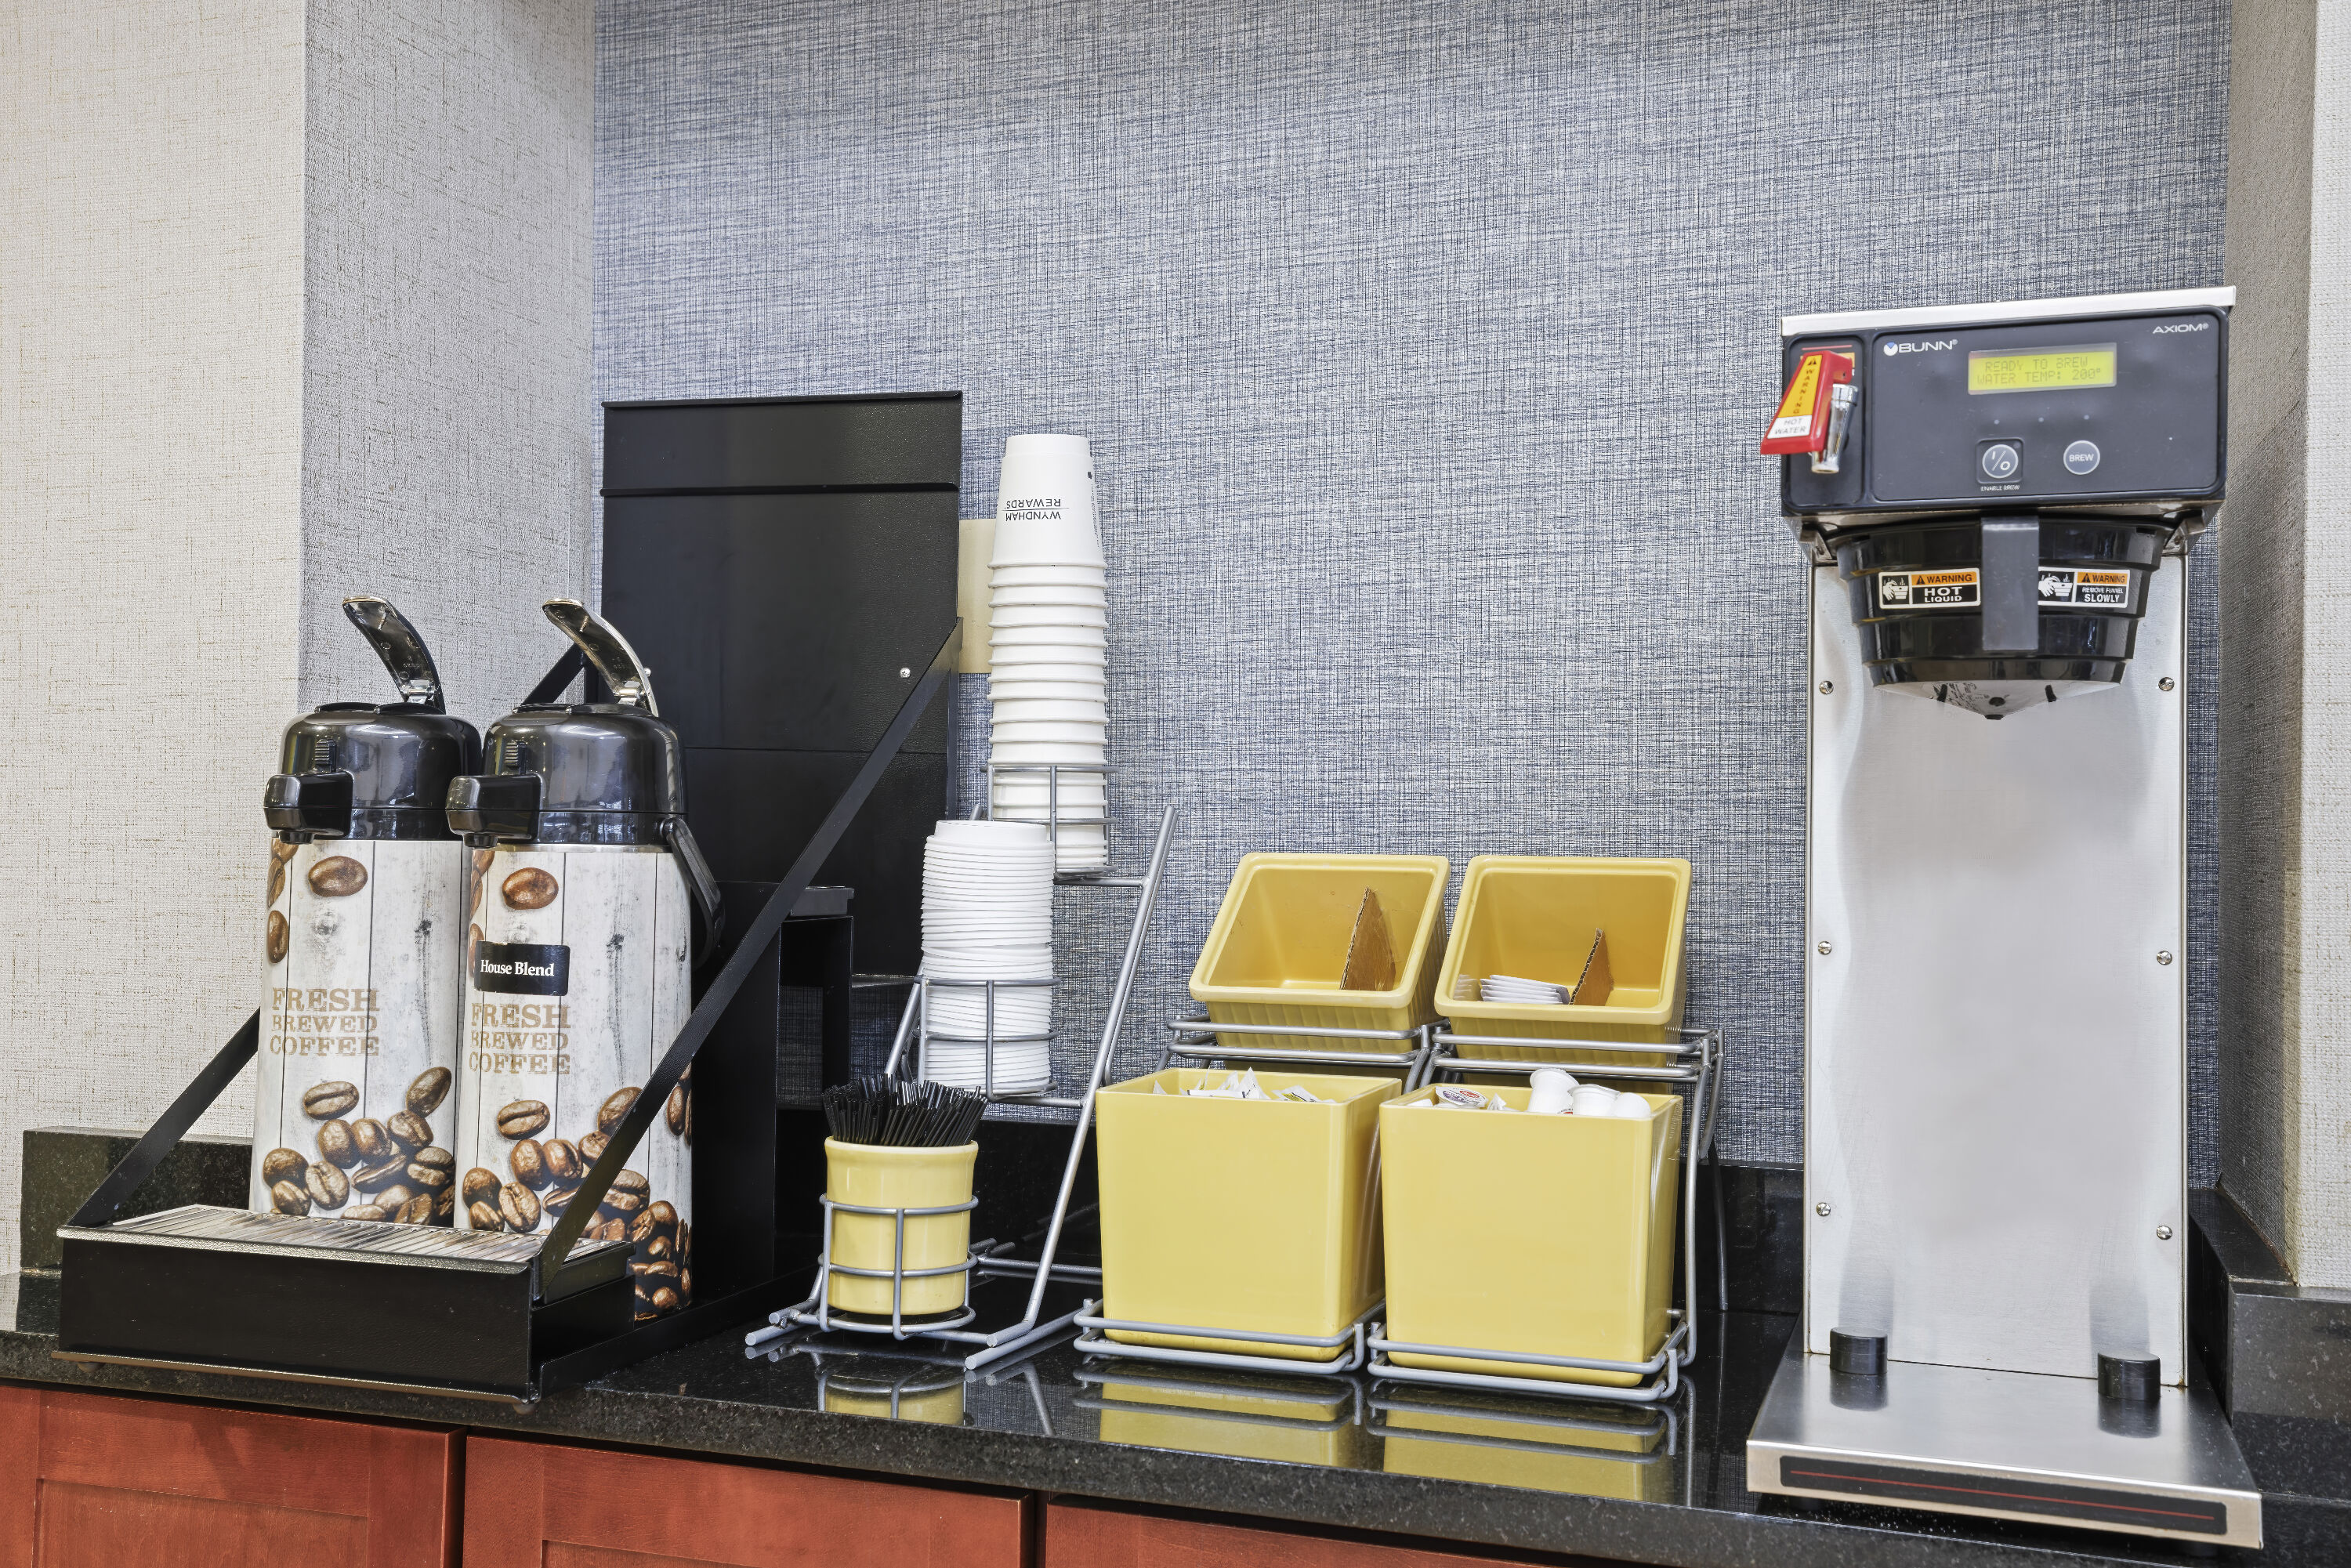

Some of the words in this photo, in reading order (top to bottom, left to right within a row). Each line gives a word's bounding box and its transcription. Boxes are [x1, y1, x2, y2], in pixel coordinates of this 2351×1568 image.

[1985, 360, 2023, 373] READY
[2033, 358, 2048, 370] TO
[2056, 357, 2088, 369] BREW
[1977, 372, 2016, 385] WATER
[2024, 371, 2061, 382] TEMP:
[2068, 454, 2095, 462] BREW
[1005, 511, 1061, 521] WYNDHAM
[1927, 574, 1972, 584] WARNING
[2092, 574, 2126, 583] WARNING
[1924, 587, 1963, 596] HOT
[2085, 594, 2120, 603] SLOWLY
[480, 960, 513, 975] House
[514, 961, 555, 976] Blend
[272, 987, 380, 1012] FRESH
[272, 1015, 378, 1033] BREWED
[471, 1003, 571, 1029] FRESH
[270, 1035, 379, 1056] COFFEE
[470, 1030, 569, 1051] BREWED
[469, 1051, 571, 1075] COFFEE
